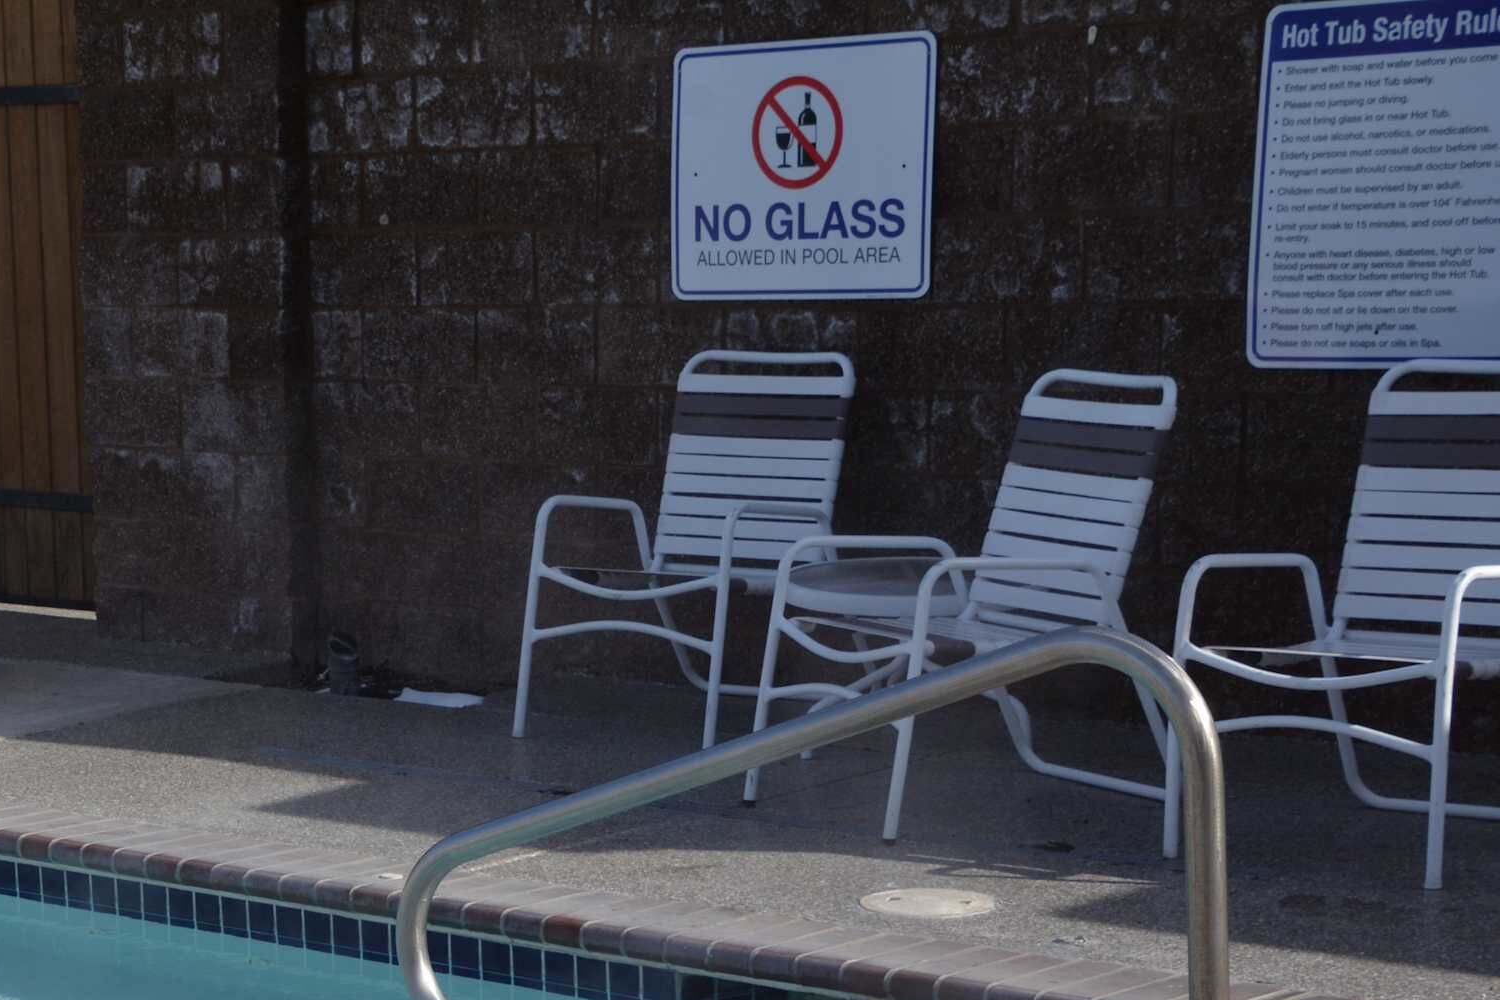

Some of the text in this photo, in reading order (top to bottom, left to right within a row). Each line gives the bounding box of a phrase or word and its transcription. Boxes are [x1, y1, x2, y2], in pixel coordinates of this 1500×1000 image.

[1282, 23, 1319, 49] Hot
[1325, 18, 1366, 46] Tub
[1373, 13, 1449, 43] Safety
[1286, 54, 1497, 75] Shower with soap and water before you come
[1285, 83, 1306, 92] Enter
[1310, 81, 1325, 91] and
[1328, 81, 1344, 90] exit
[1347, 80, 1361, 89] the
[1364, 79, 1380, 88] Hot
[1383, 77, 1400, 86] Tub
[1284, 100, 1311, 109] Please
[1315, 100, 1325, 108] no
[1327, 98, 1364, 109] jumping
[1282, 117, 1294, 126] Do
[1296, 116, 1311, 125] not
[1313, 116, 1335, 125] bring
[1338, 114, 1362, 125] glass
[1364, 113, 1372, 121] in
[1388, 112, 1407, 120] near
[1411, 110, 1427, 119] Hot
[1281, 134, 1293, 143] Do
[1295, 134, 1309, 142] not
[1312, 134, 1327, 142] use
[1280, 151, 1308, 161] Elderly
[1312, 150, 1346, 160] persons
[1349, 148, 1371, 157] must
[1374, 146, 1408, 156] consult
[1412, 145, 1442, 154] doctor
[1445, 143, 1477, 152] before
[1278, 167, 1317, 178] Pregnant
[1321, 167, 1352, 175] women
[1355, 164, 1385, 173] should
[1388, 162, 1421, 172] consult
[1425, 162, 1456, 170] doctor
[1460, 160, 1491, 169] before
[1278, 186, 1313, 195] Children
[1316, 185, 1337, 194] must
[1340, 184, 1351, 193] be
[1354, 182, 1404, 194] supervised
[1407, 182, 1418, 192] by
[1277, 203, 1288, 212] Do
[1290, 203, 1305, 212] not
[1307, 203, 1330, 211] enter
[1340, 201, 1396, 211] temperature
[1408, 200, 1429, 208] over
[694, 198, 905, 243] NO GLASS
[1275, 222, 1296, 231] Limit
[1299, 223, 1317, 232] your
[1320, 220, 1340, 230] soak
[1344, 221, 1352, 229] to
[1411, 218, 1428, 227] and
[1432, 217, 1451, 226] cool
[1455, 217, 1468, 225] off
[696, 246, 901, 267] ALLOWED IN POOL AREA
[1274, 250, 1306, 261] Anyone
[1308, 249, 1326, 258] with
[1329, 249, 1351, 258] heart
[1440, 246, 1461, 257] high
[1477, 246, 1494, 255] low
[1273, 261, 1297, 271] blood
[1300, 262, 1338, 272] pressure
[1352, 262, 1367, 270] any
[1370, 260, 1404, 268] serious
[1439, 258, 1471, 267] should
[1272, 273, 1303, 282] consult
[1306, 273, 1324, 281] with
[1327, 272, 1356, 281] doctor
[1358, 272, 1388, 281] before
[1390, 272, 1428, 281] entering
[1431, 271, 1446, 280] the
[1449, 271, 1465, 279] Hot
[1272, 289, 1300, 298] Please
[1302, 289, 1334, 299] replace
[1338, 289, 1354, 299] Spa
[1385, 288, 1407, 297] after
[1408, 288, 1431, 297] each
[1271, 305, 1300, 314] Please
[1303, 305, 1312, 314] do
[1316, 306, 1330, 314] not
[1370, 305, 1395, 314] down
[1412, 305, 1427, 313] the
[1270, 322, 1298, 331] Please
[1301, 322, 1318, 330] turn
[1321, 322, 1333, 330] off
[1335, 321, 1354, 332] high
[1355, 322, 1372, 332] jets
[1375, 321, 1395, 330] after
[1270, 338, 1297, 347] Please
[1300, 339, 1311, 347] do
[1314, 339, 1328, 347] not
[1349, 340, 1375, 349] soaps
[1390, 339, 1406, 347] oils
[1409, 339, 1417, 347] in
